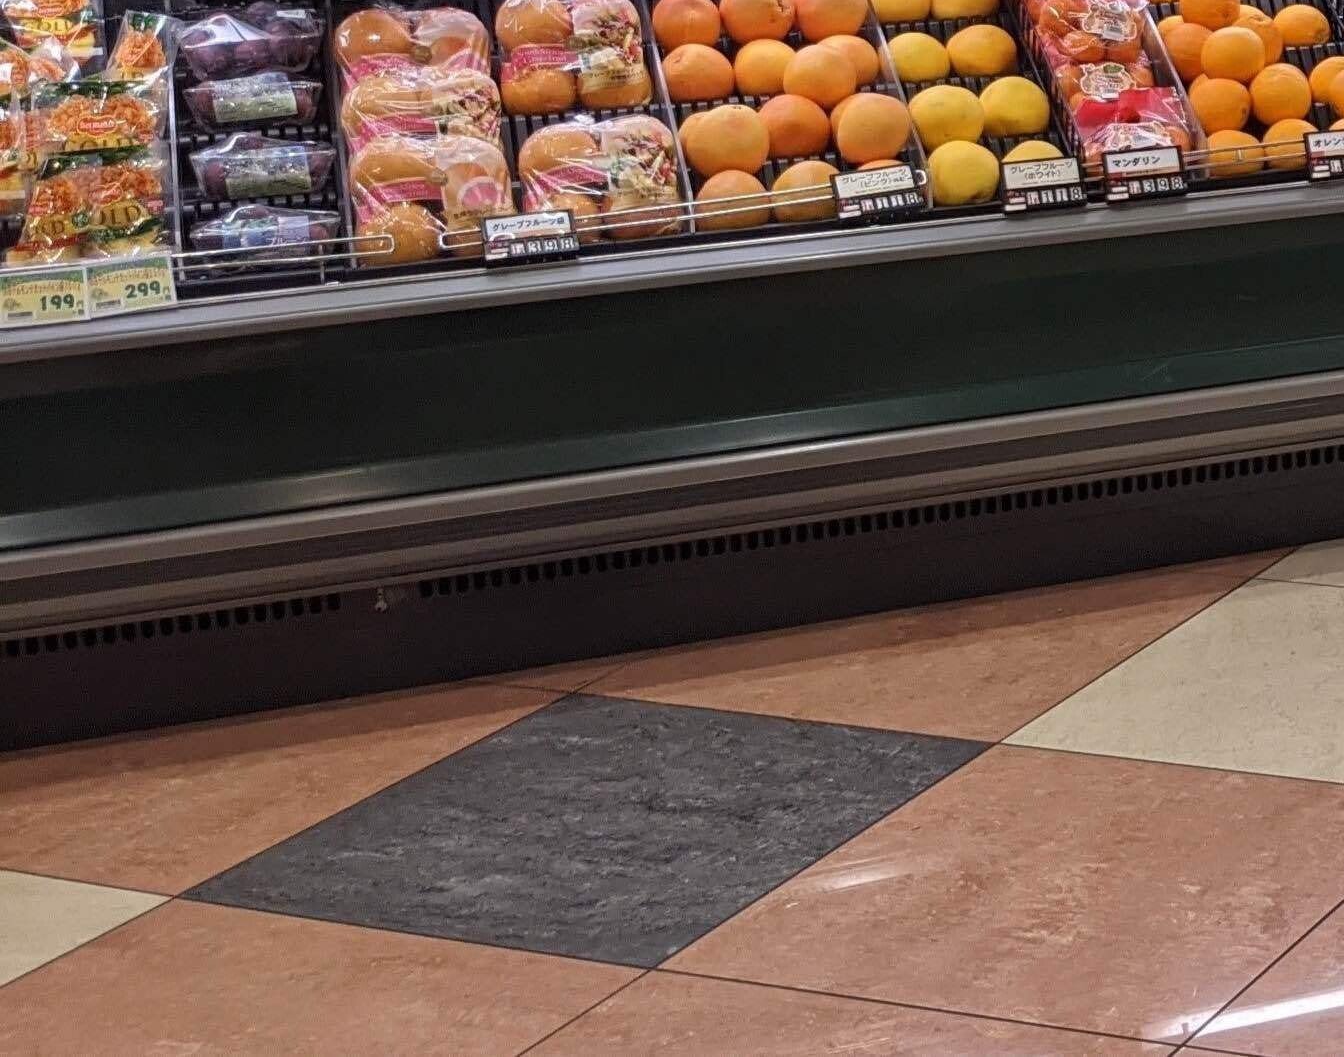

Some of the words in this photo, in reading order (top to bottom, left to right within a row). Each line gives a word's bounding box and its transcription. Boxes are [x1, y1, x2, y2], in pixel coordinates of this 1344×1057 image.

[1111, 156, 1161, 169] マンダリン
